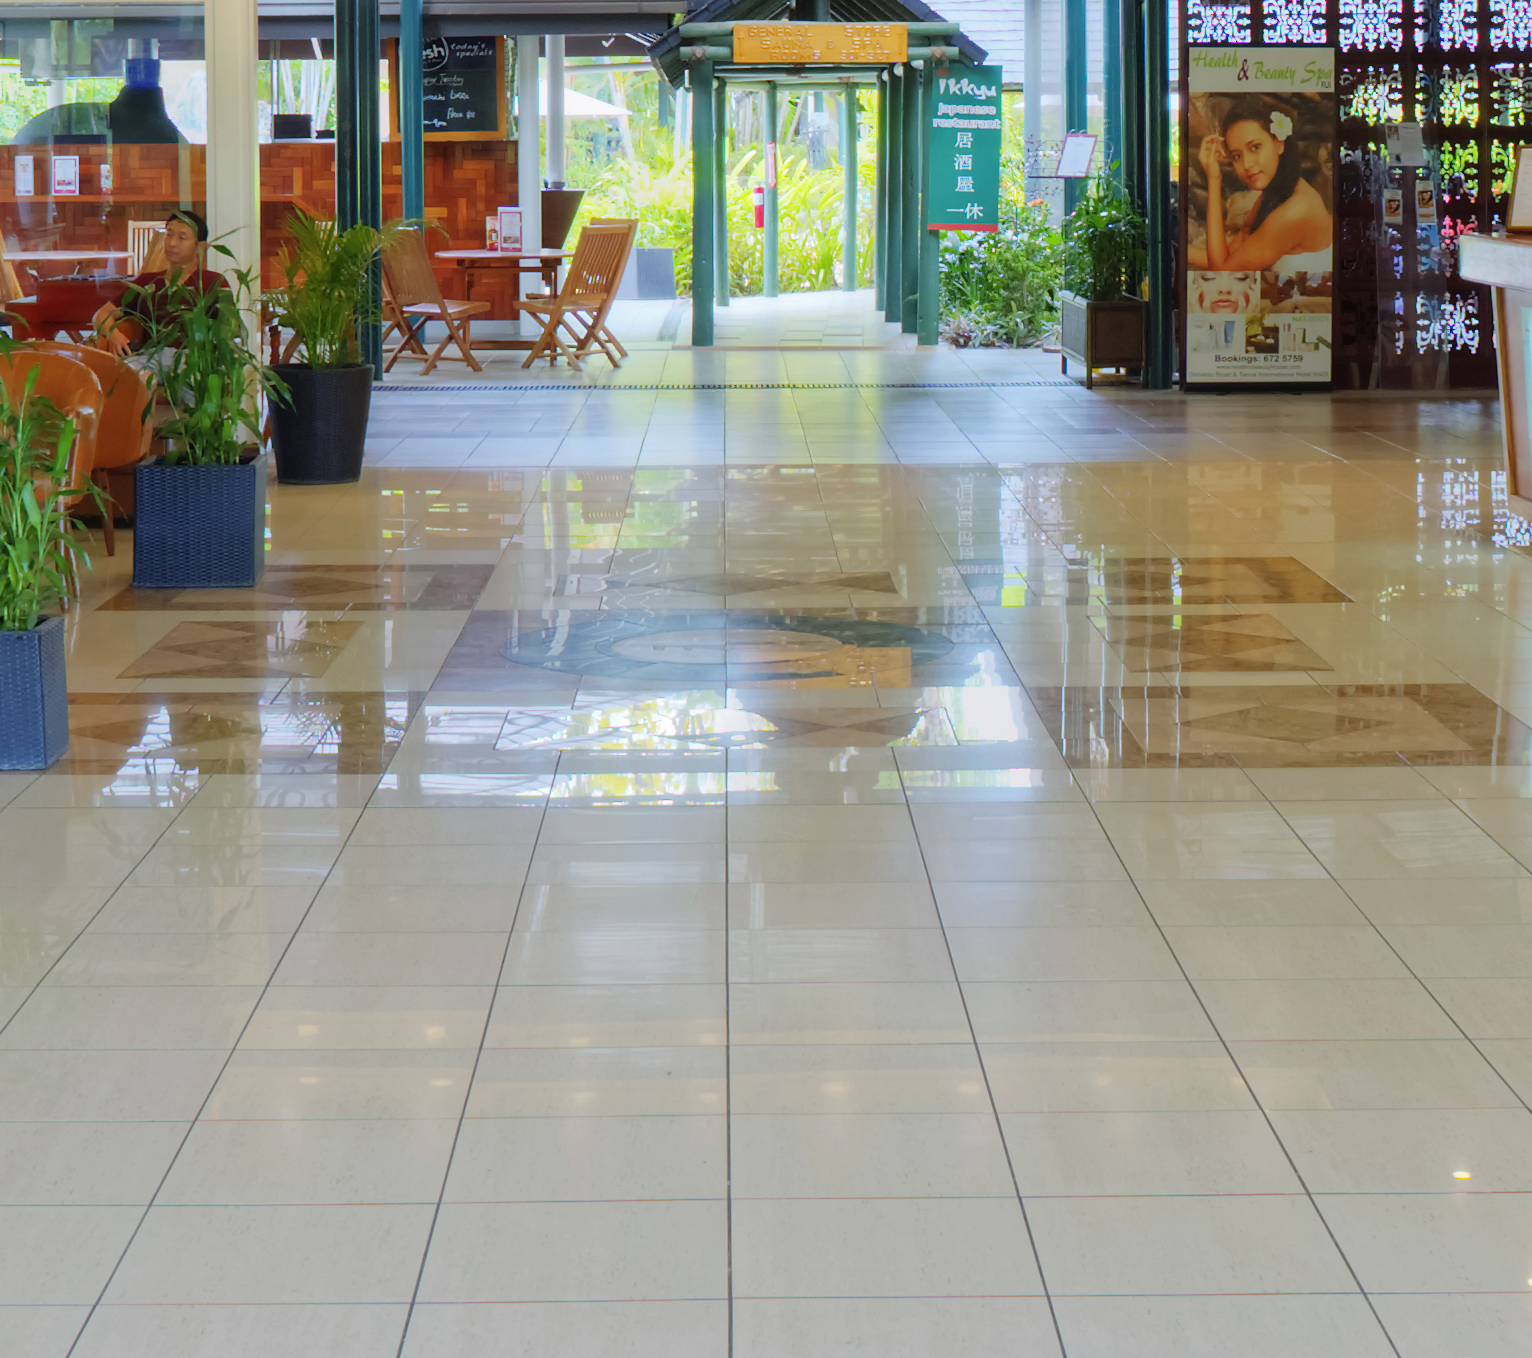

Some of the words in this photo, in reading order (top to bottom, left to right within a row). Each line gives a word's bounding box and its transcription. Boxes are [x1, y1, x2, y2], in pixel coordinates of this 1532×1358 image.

[748, 25, 813, 38] GENERAL
[844, 25, 891, 38] STORE
[451, 41, 486, 52] today's
[760, 37, 814, 50] SAUNA
[851, 37, 884, 50] SPA
[456, 48, 494, 59] specials
[770, 49, 822, 61] ROOMS
[1192, 49, 1238, 68] Health
[1237, 58, 1250, 82] &
[1253, 61, 1296, 86] Beauty
[1300, 60, 1333, 87] Spa
[938, 77, 997, 100] Ikkyu
[932, 117, 1001, 130] restaurant
[946, 202, 984, 220] 一休
[1215, 354, 1260, 364] Bookings:
[1263, 354, 1280, 363] 672
